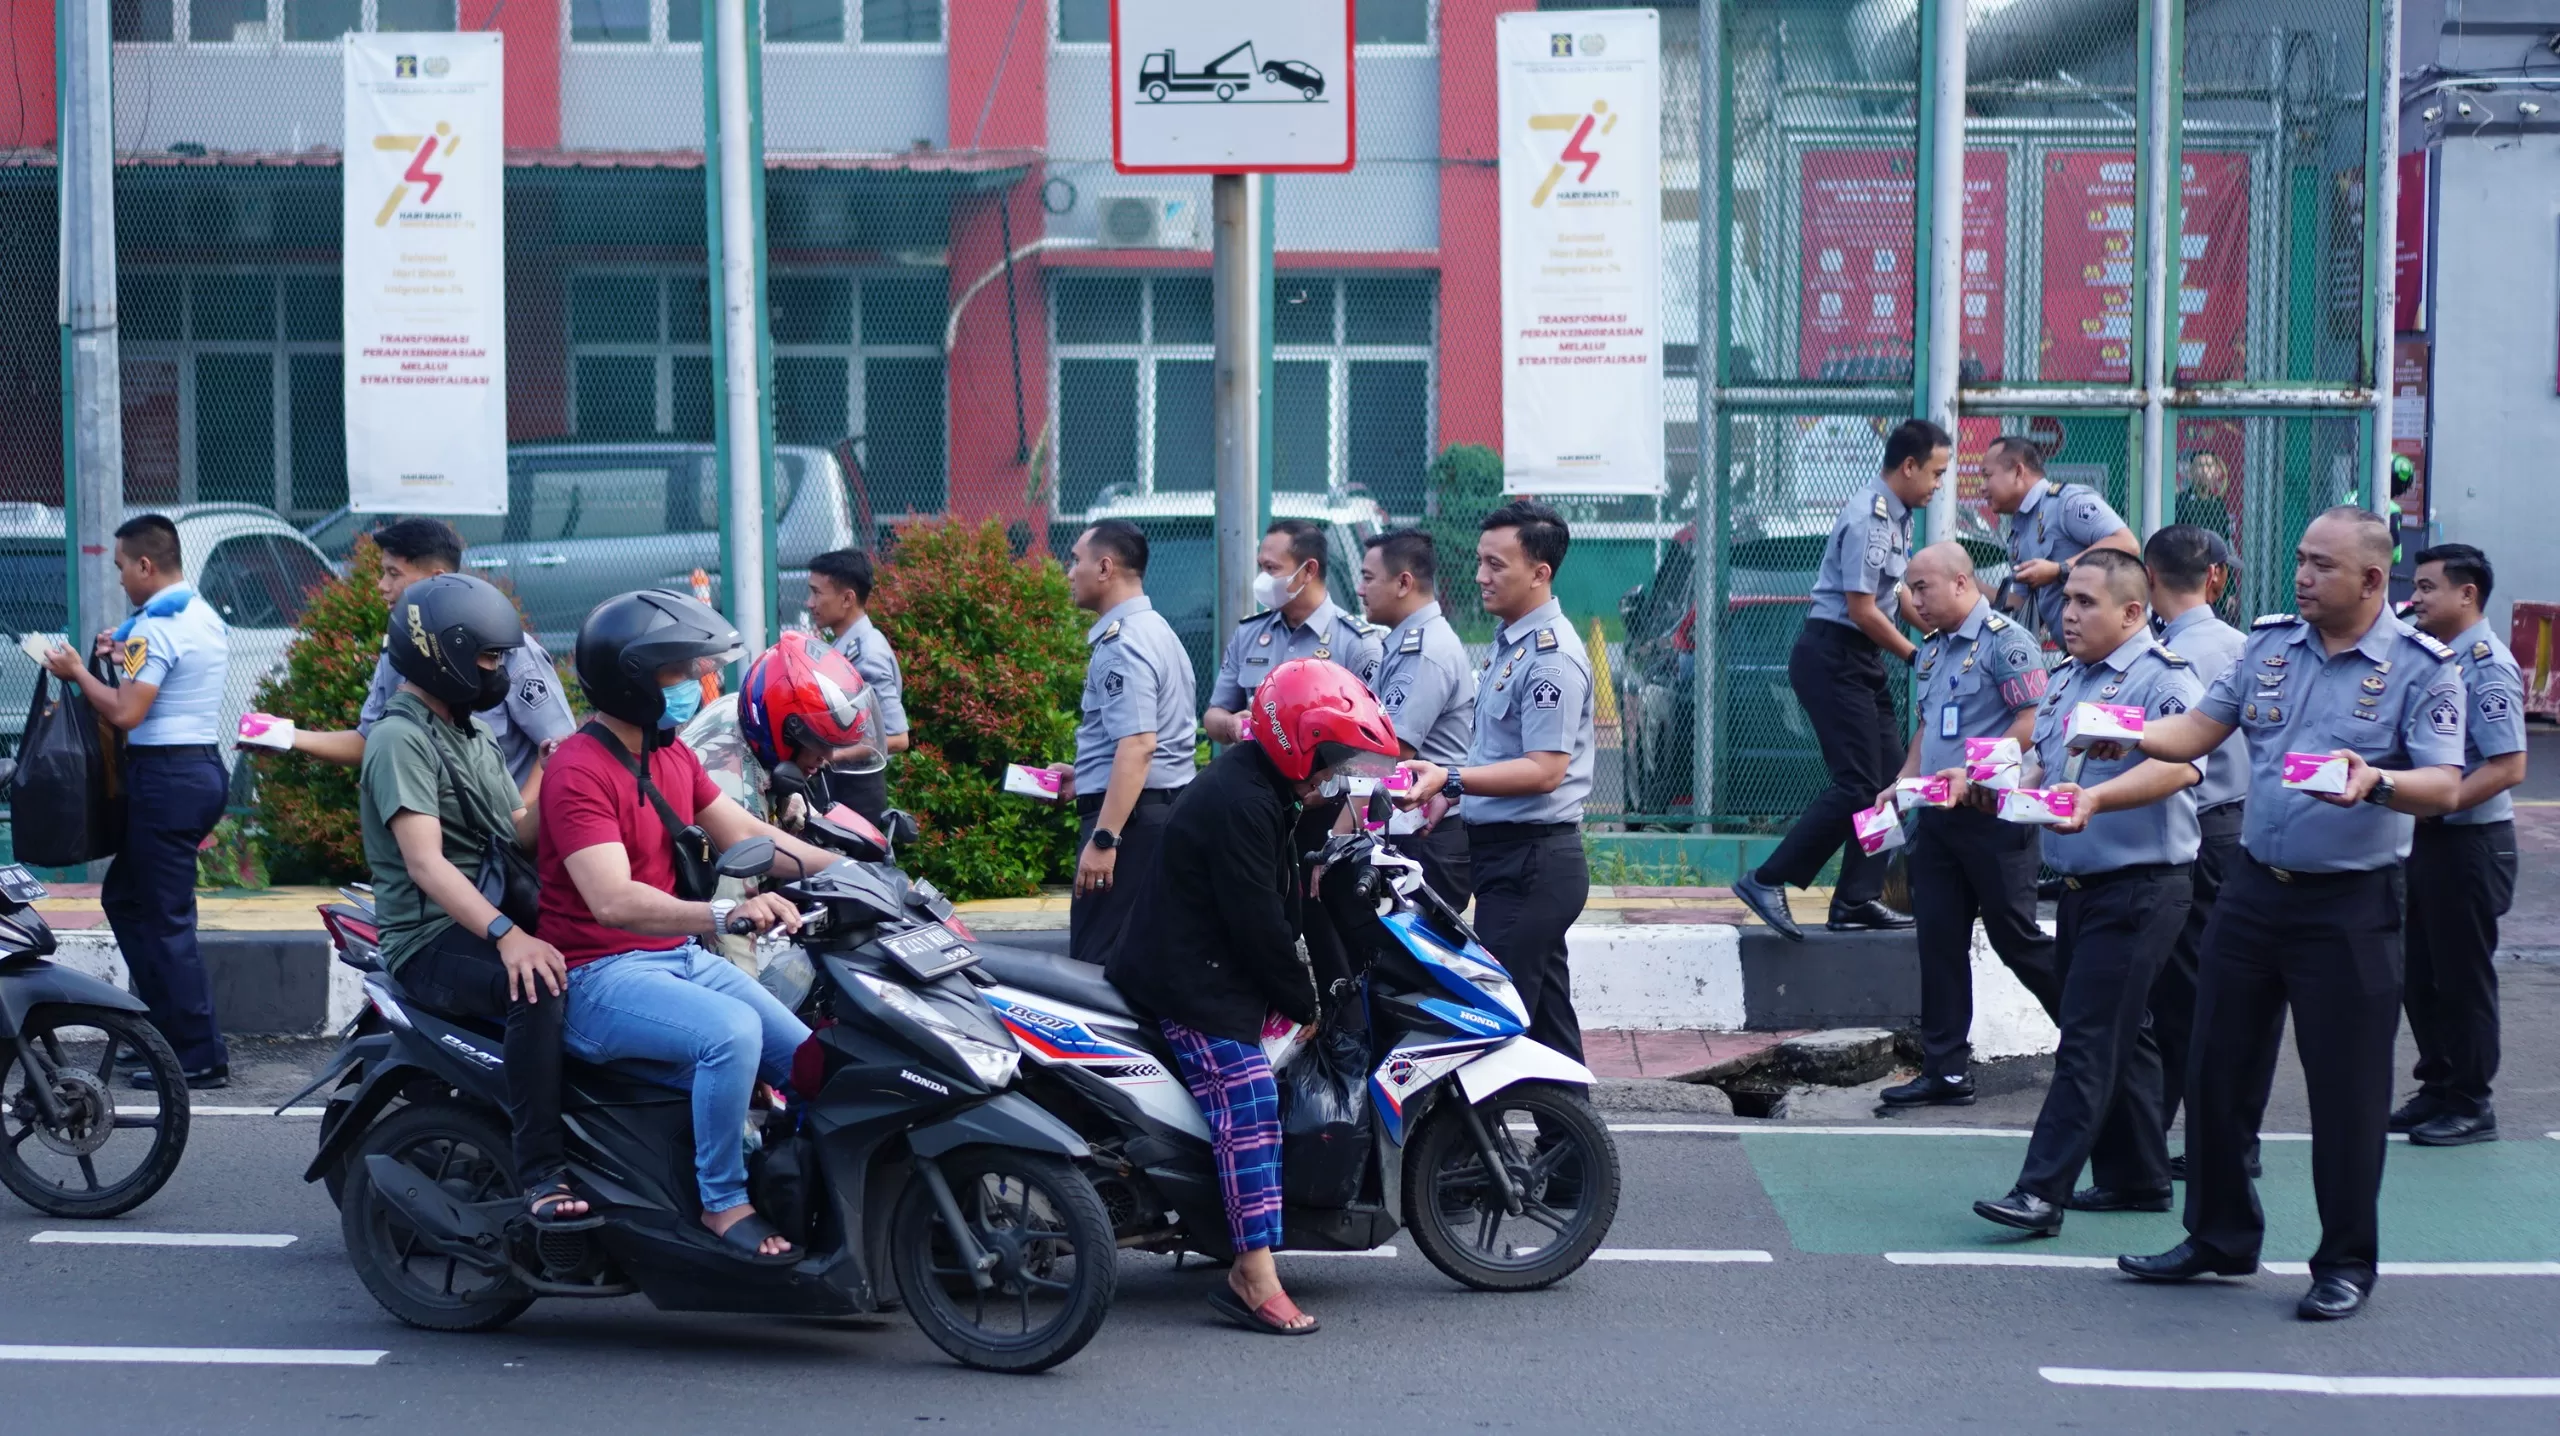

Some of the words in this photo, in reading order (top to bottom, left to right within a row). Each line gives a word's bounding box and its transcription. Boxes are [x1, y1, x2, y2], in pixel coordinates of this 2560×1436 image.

[1557, 191, 1580, 200] HARI
[1582, 190, 1620, 199] BHAKTI
[399, 211, 423, 220] HARI
[425, 211, 462, 220] BHAKTI
[1538, 314, 1628, 324] TRANSFORMASI
[1520, 328, 1558, 338] PERAN
[1560, 327, 1644, 337] KEIMIGRASIAN
[380, 334, 470, 344] TRANSFORMASI
[1558, 341, 1606, 351] MELALUI
[362, 347, 401, 357] PERAN
[402, 347, 486, 357] KEIMIGRASIAN
[1518, 355, 1573, 366] STRATEGI
[1574, 354, 1647, 365] DIGITALISASI
[400, 361, 448, 371] MELALUI
[360, 375, 414, 385] STRATEGI
[415, 375, 490, 385] DIGITALISASI
[1460, 1010, 1501, 1031] HONDA
[900, 1069, 949, 1096] HONDA
